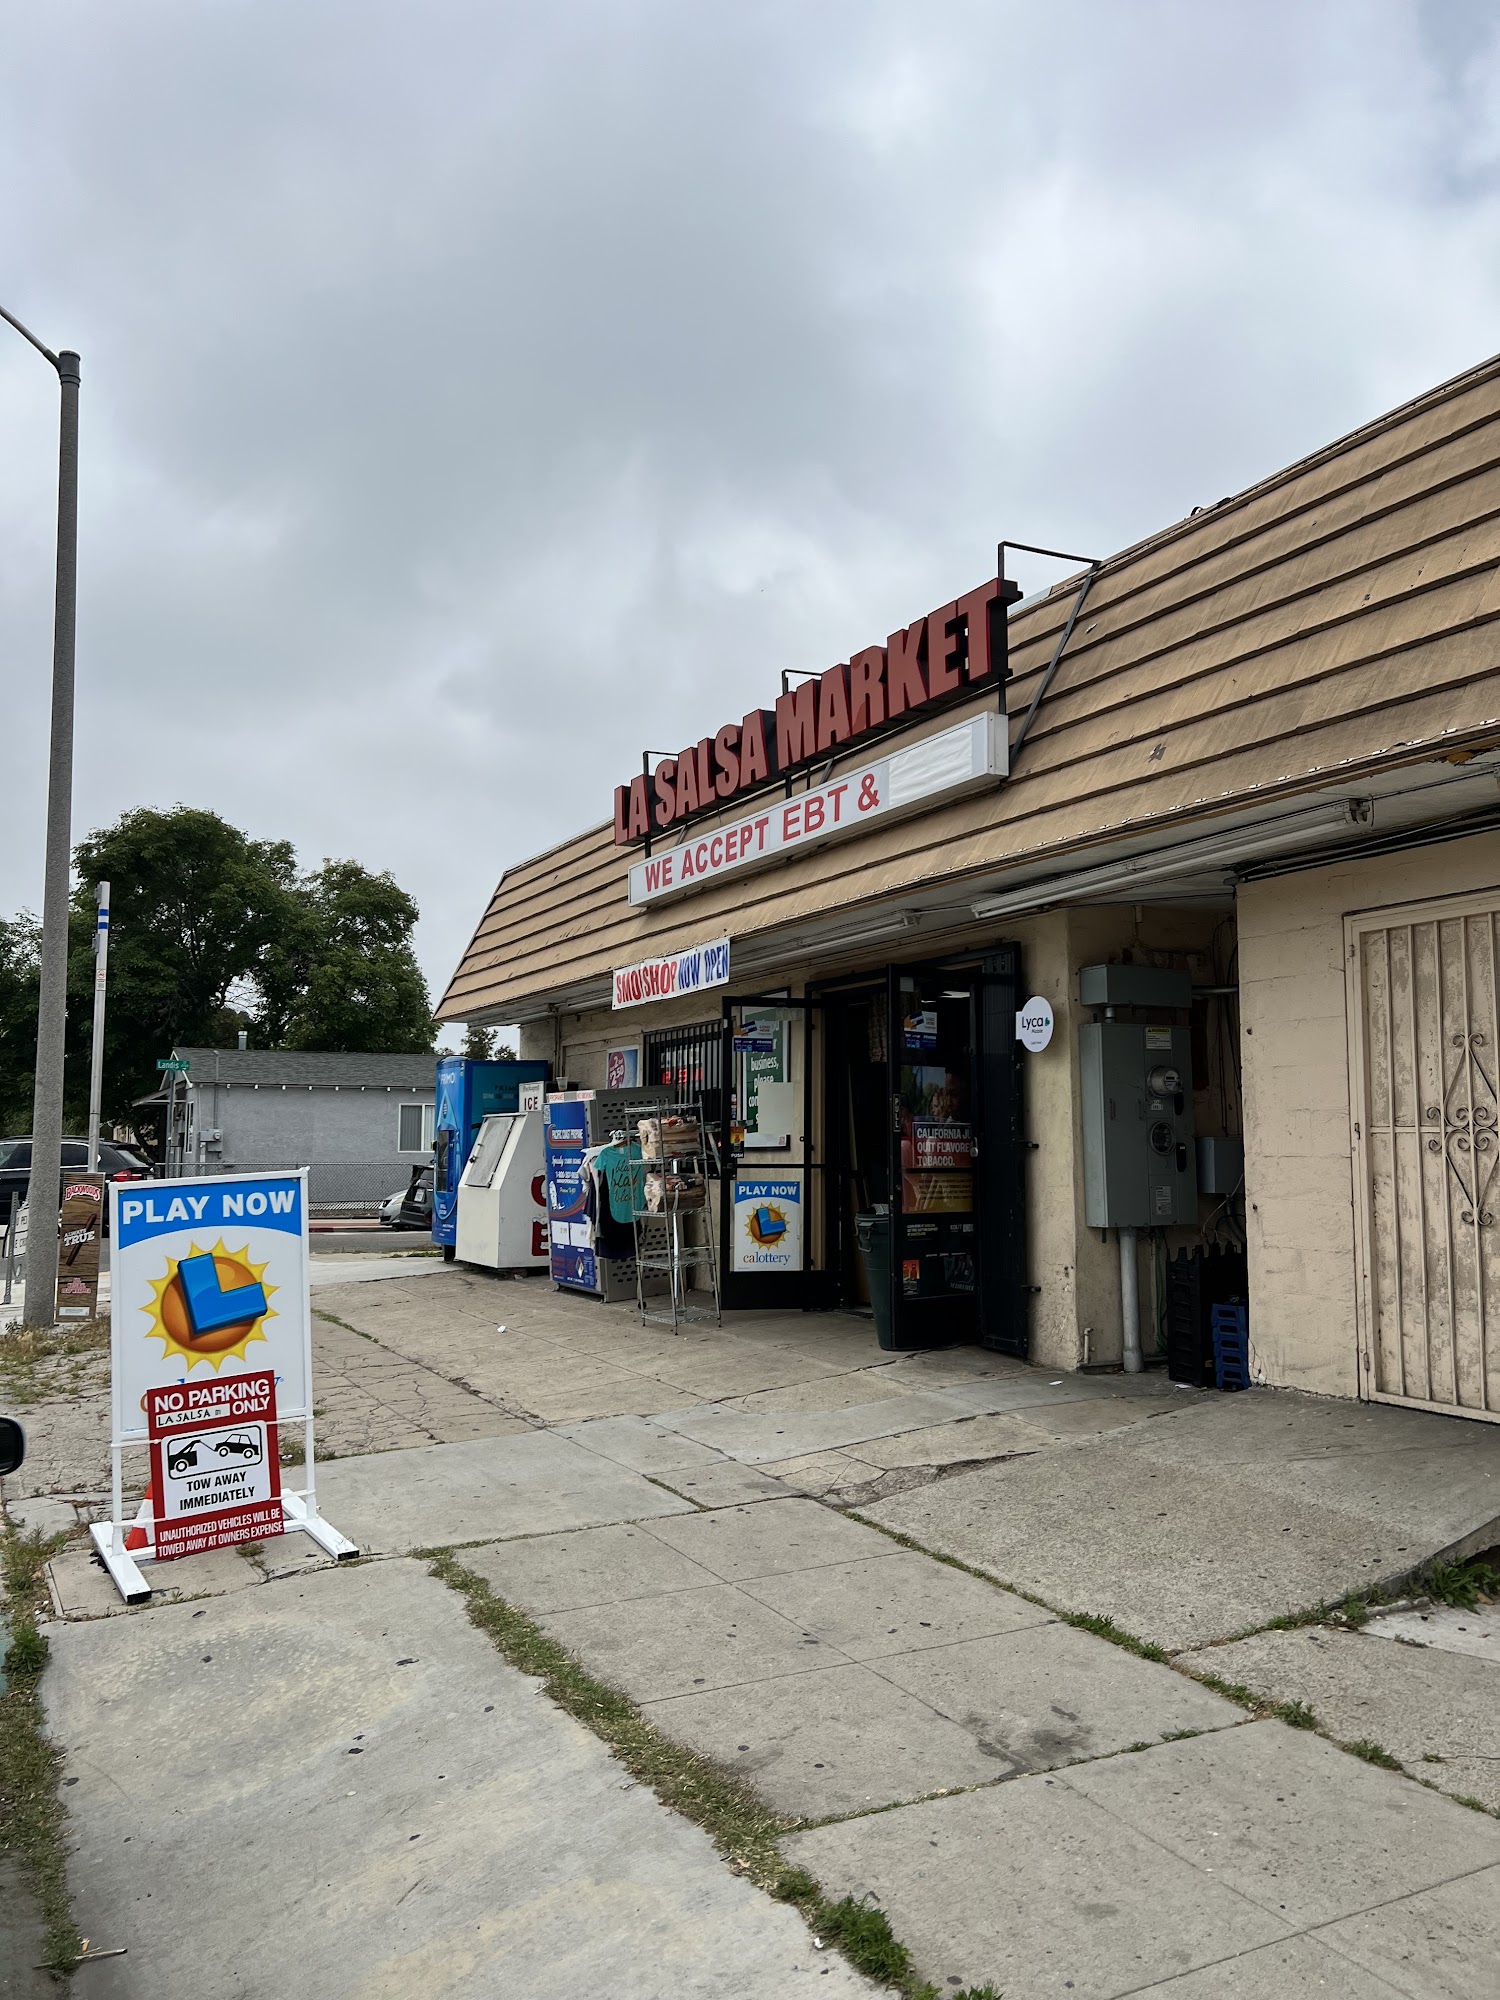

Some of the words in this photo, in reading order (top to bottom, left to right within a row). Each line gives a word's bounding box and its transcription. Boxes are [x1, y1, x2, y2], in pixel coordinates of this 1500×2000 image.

[614, 774, 649, 846] LA
[655, 709, 769, 826] SALSA
[776, 577, 1001, 771] MARKET
[645, 856, 673, 893] WE
[681, 816, 769, 880] ACCEPT
[783, 784, 848, 842] EBT
[858, 773, 880, 812] &
[616, 968, 645, 1004] SMO
[642, 961, 678, 997] SHOP
[678, 952, 701, 990] NOW
[704, 943, 729, 983] OPEN
[1021, 1016, 1044, 1030] Lyca
[157, 1060, 179, 1069] Landis
[751, 1058, 779, 1071] business,
[524, 1096, 538, 1110] ICE
[917, 1127, 962, 1139] CALIFORNIA
[917, 1141, 935, 1153] QUIT
[936, 1140, 971, 1153] FLAVORE
[917, 1155, 956, 1167] TOBACCO.
[65, 1184, 101, 1201] BACKWOODS
[738, 1185, 768, 1196] PLAY
[771, 1185, 797, 1196] NOW
[122, 1196, 211, 1225] PLAY
[222, 1190, 296, 1218] NOW
[63, 1230, 95, 1247] TRUE
[743, 1251, 791, 1266] calottery
[154, 1393, 184, 1413] NO
[188, 1378, 270, 1408] PARKING
[232, 1396, 271, 1415] ONLY
[158, 1414, 174, 1427] LA
[175, 1409, 211, 1423] SALSA
[186, 1476, 211, 1492] TOW
[214, 1471, 247, 1487] AWAY
[179, 1486, 256, 1511] IMMEDIATELY
[159, 1520, 218, 1543] UNAUTHORIZED
[217, 1513, 252, 1531] VEHICLES
[252, 1510, 270, 1523] WILL
[271, 1507, 281, 1519] BE
[158, 1544, 185, 1558] TOWED
[185, 1539, 207, 1552] AWAY
[207, 1537, 217, 1548] AT
[218, 1530, 250, 1545] OWNERS
[250, 1520, 283, 1538] EXPENSE
